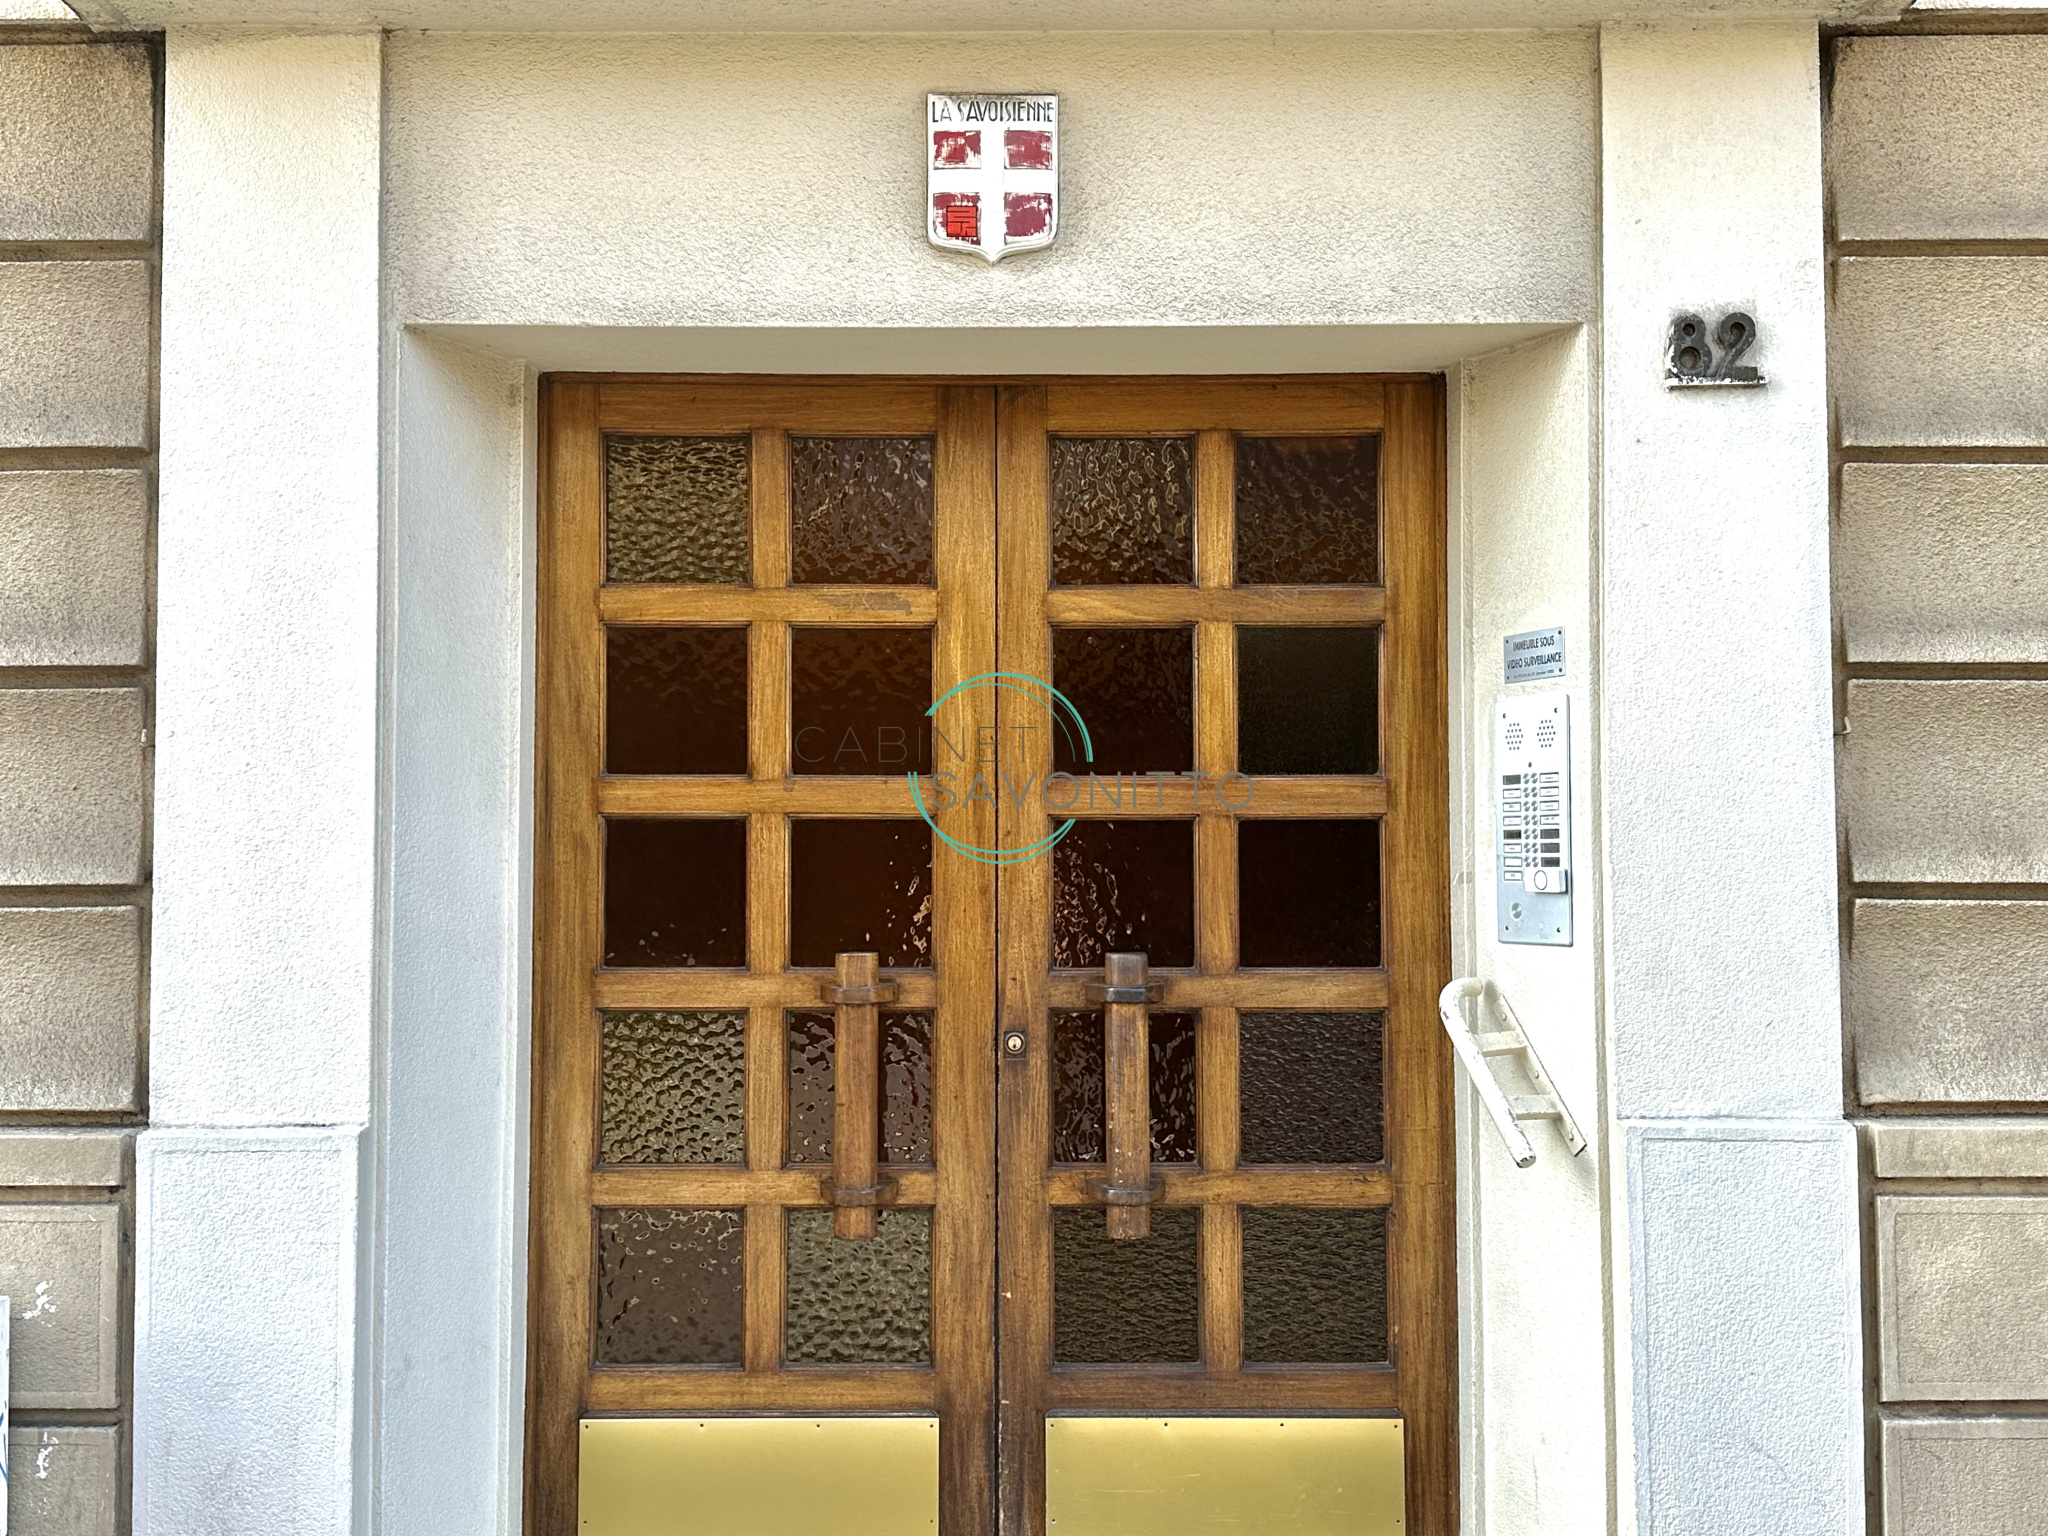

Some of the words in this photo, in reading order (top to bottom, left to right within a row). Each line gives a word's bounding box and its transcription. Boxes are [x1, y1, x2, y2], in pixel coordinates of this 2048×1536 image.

[932, 101, 952, 122] LA
[957, 100, 1055, 122] SAVOISIENNE
[1669, 311, 1758, 380] 82
[1512, 637, 1539, 652] IMMEUBLE
[1540, 634, 1555, 648] SOUS
[1506, 657, 1523, 670] VIDEO
[1523, 651, 1562, 668] SURVEILLANCE
